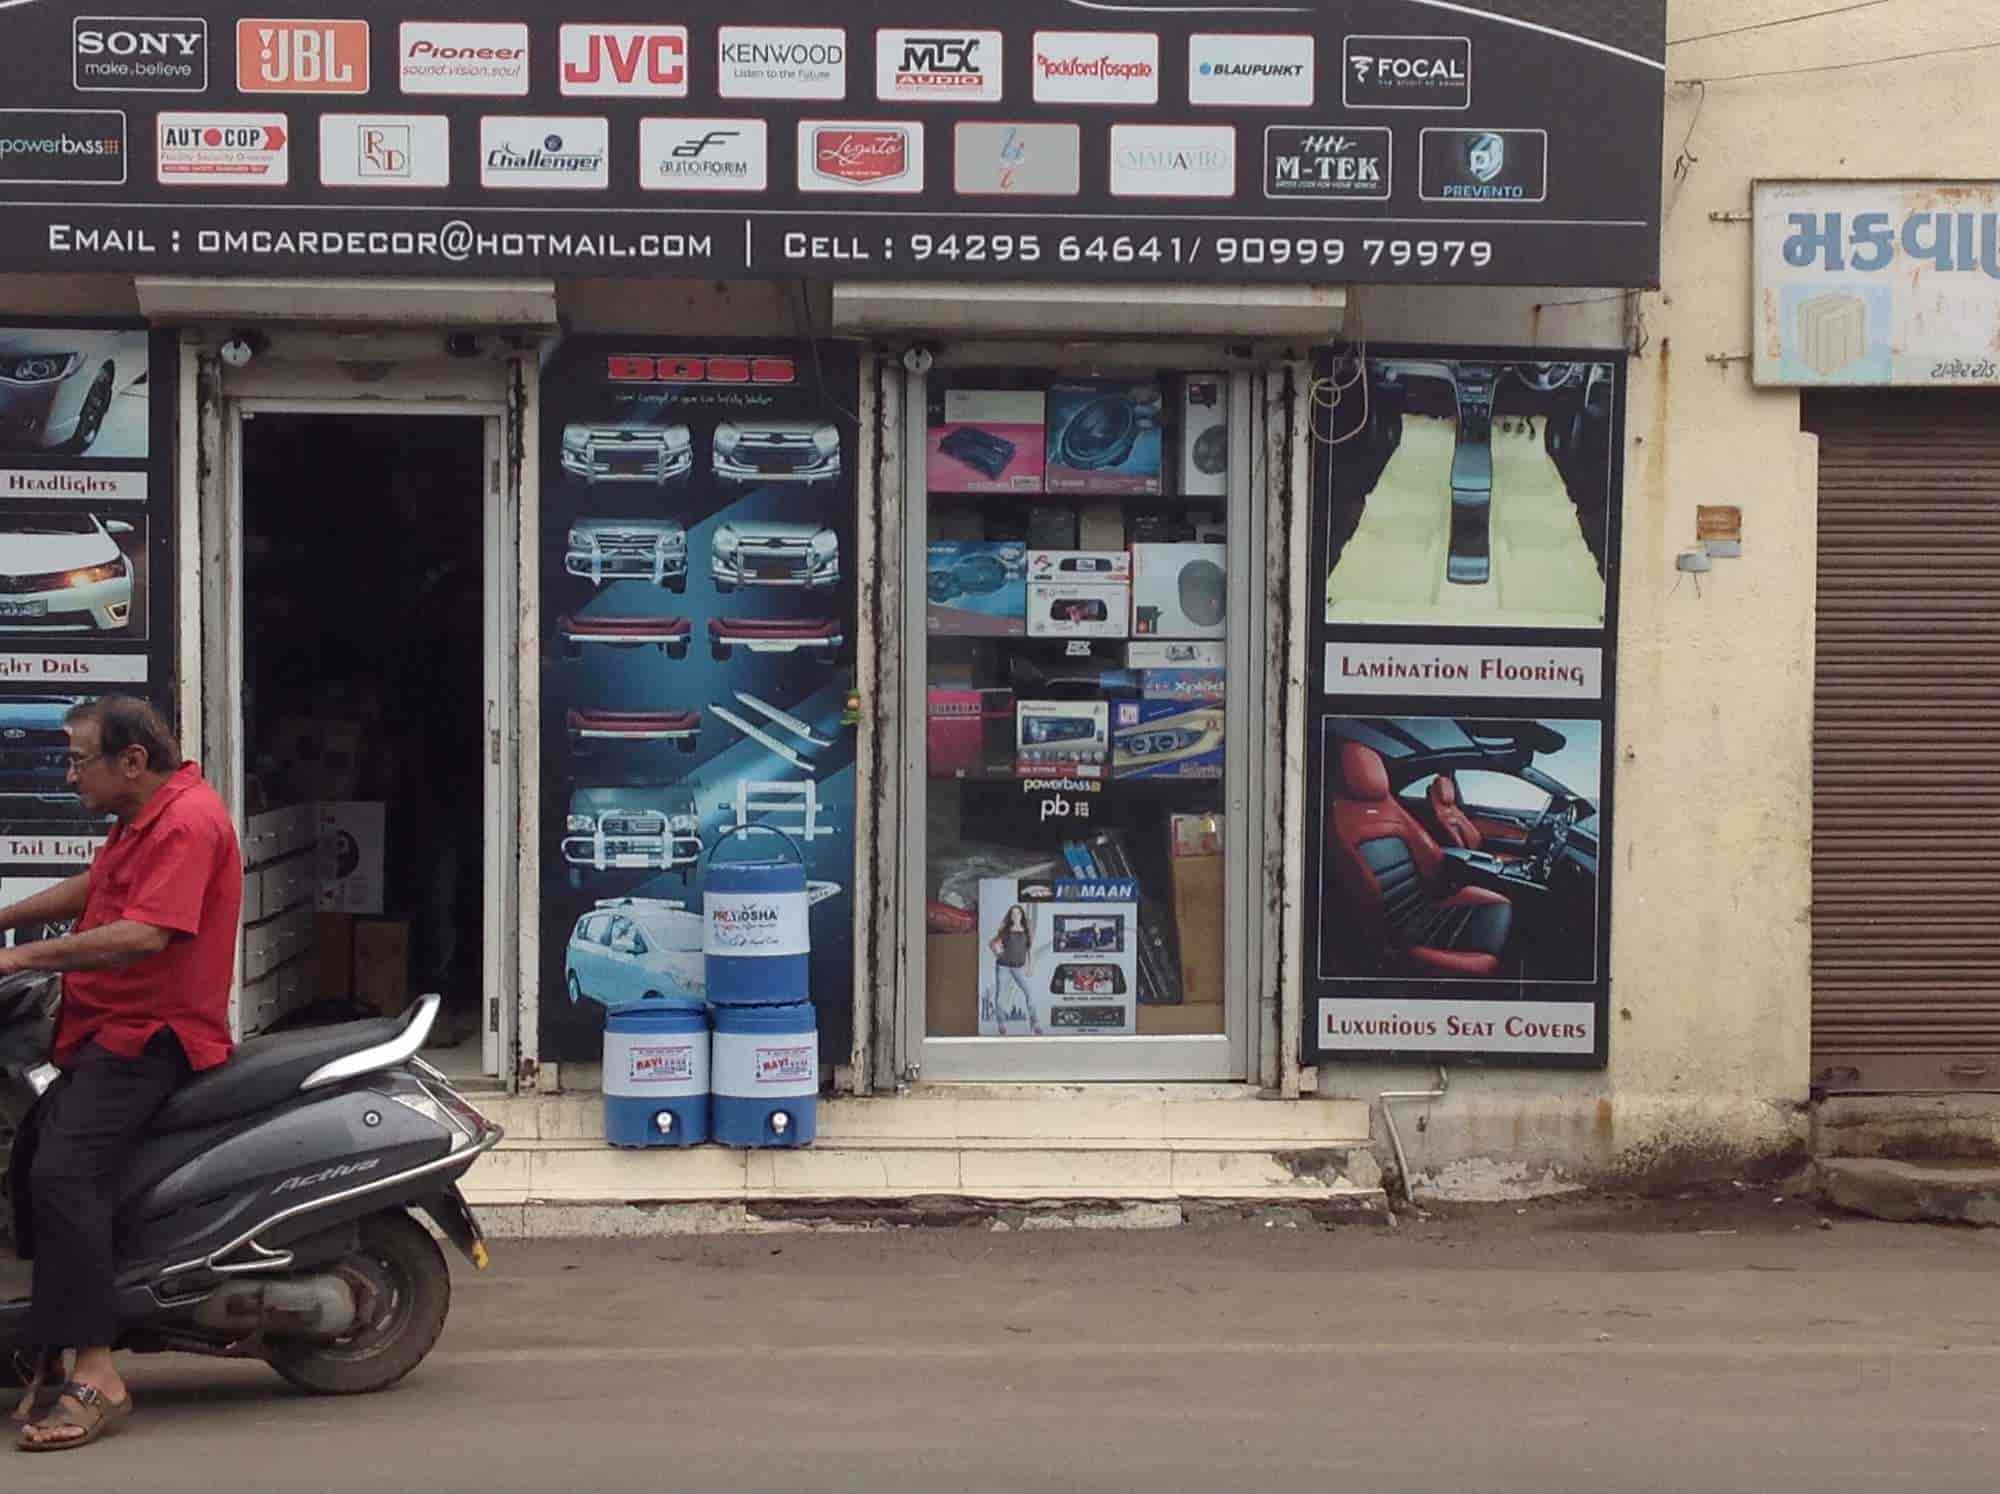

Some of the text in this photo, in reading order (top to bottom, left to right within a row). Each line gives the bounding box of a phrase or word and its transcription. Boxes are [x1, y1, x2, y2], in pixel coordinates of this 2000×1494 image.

[77, 31, 201, 55] SONY
[408, 40, 525, 60] Pioneer
[721, 43, 843, 65] KENWOOD
[898, 37, 981, 73] MTX
[258, 28, 353, 83] JBL
[564, 35, 684, 84] JVC
[898, 75, 981, 86] AUDIO
[1213, 63, 1304, 77] BLAUPUNKT
[1378, 58, 1465, 79] FOCAL
[487, 147, 603, 171] Challenger
[1275, 156, 1381, 181] M-TEK
[1442, 184, 1523, 198] PREVENTO
[911, 234, 1041, 261] 94295
[1216, 237, 1345, 264] 90999
[1362, 239, 1493, 267] 79979
[1041, 793, 1070, 822] pb
[8, 840, 43, 856] Tail
[271, 1158, 381, 1196] Activa
